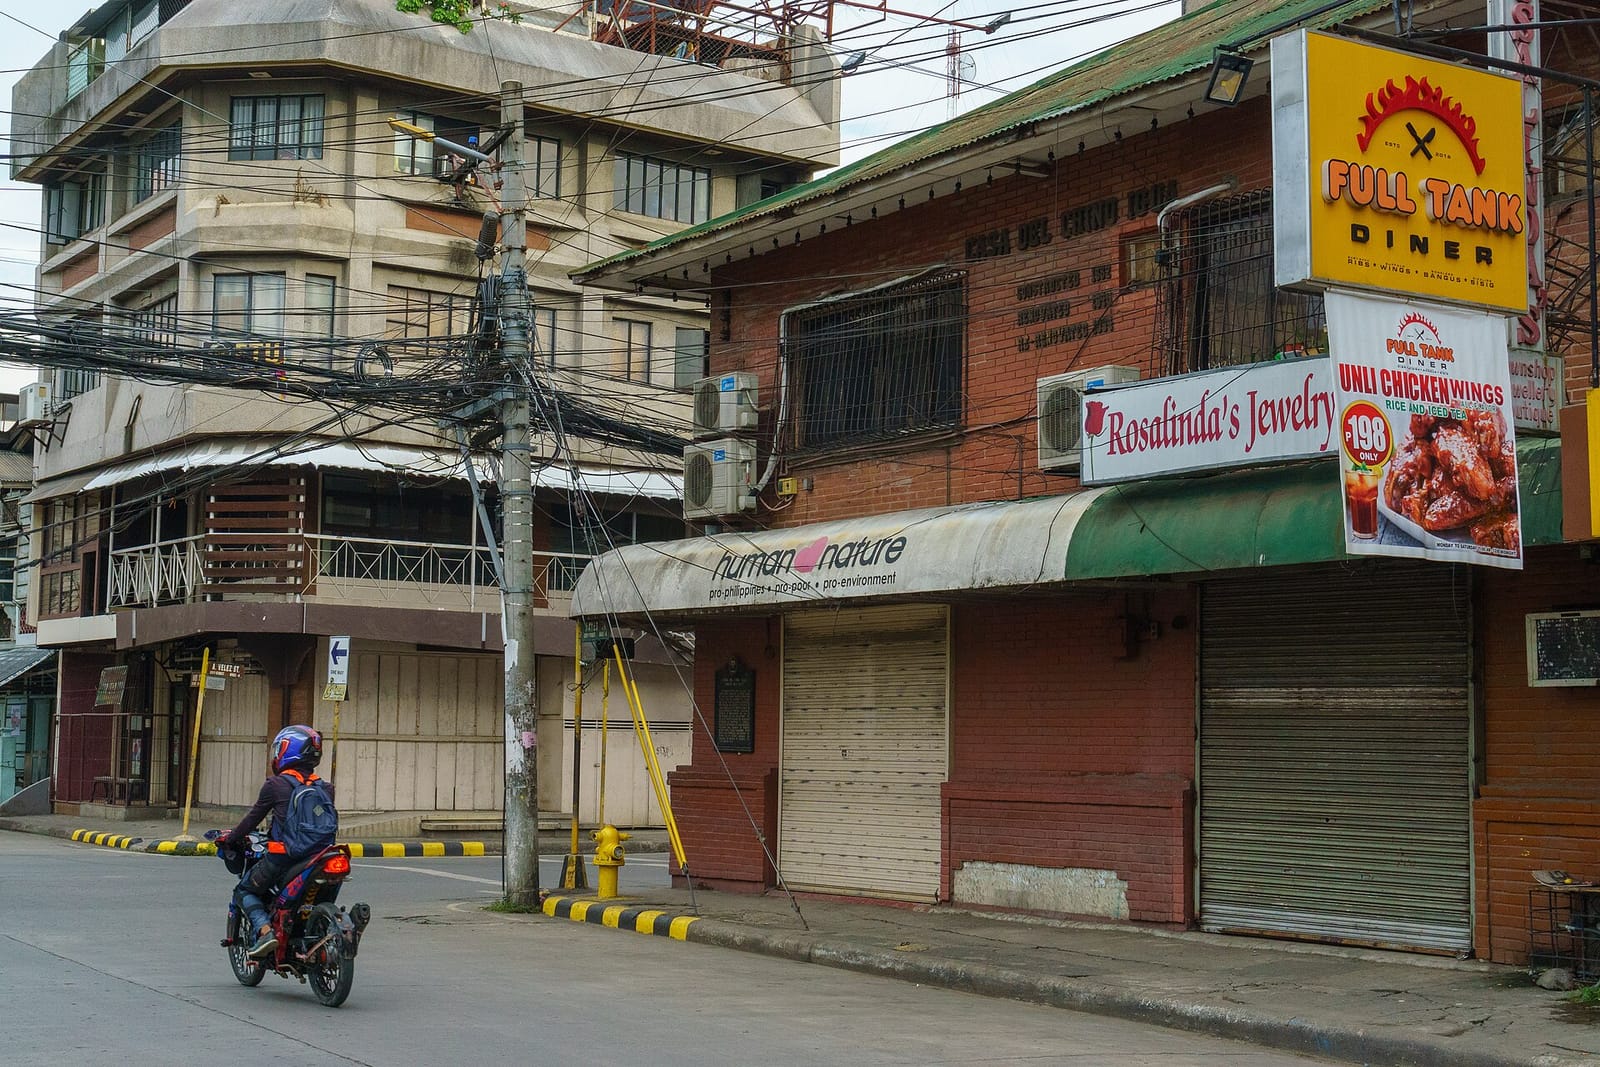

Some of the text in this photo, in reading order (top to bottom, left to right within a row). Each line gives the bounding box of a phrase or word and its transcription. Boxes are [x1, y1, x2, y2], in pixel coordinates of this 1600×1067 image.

[1323, 158, 1524, 234] FULL TANK
[1351, 223, 1493, 265] DINER
[1347, 258, 1370, 268] RIBS
[1380, 263, 1411, 275] WINGS
[1423, 271, 1461, 283] BANGUS
[1470, 279, 1495, 289] SISIG
[1386, 339, 1455, 362] FULL TANK
[1397, 356, 1447, 370] DINER
[1339, 363, 1504, 406] UNLI CHICKEN WINGS
[1106, 373, 1335, 455] Rosalinda's Jewelry
[1385, 400, 1467, 420] RICE AND ICED TEA
[1359, 452, 1379, 461] ONLY
[712, 535, 907, 581] human nature
[709, 572, 897, 600] pro-philippines pro-poor pro-environment
[217, 663, 233, 673] VELEZ
